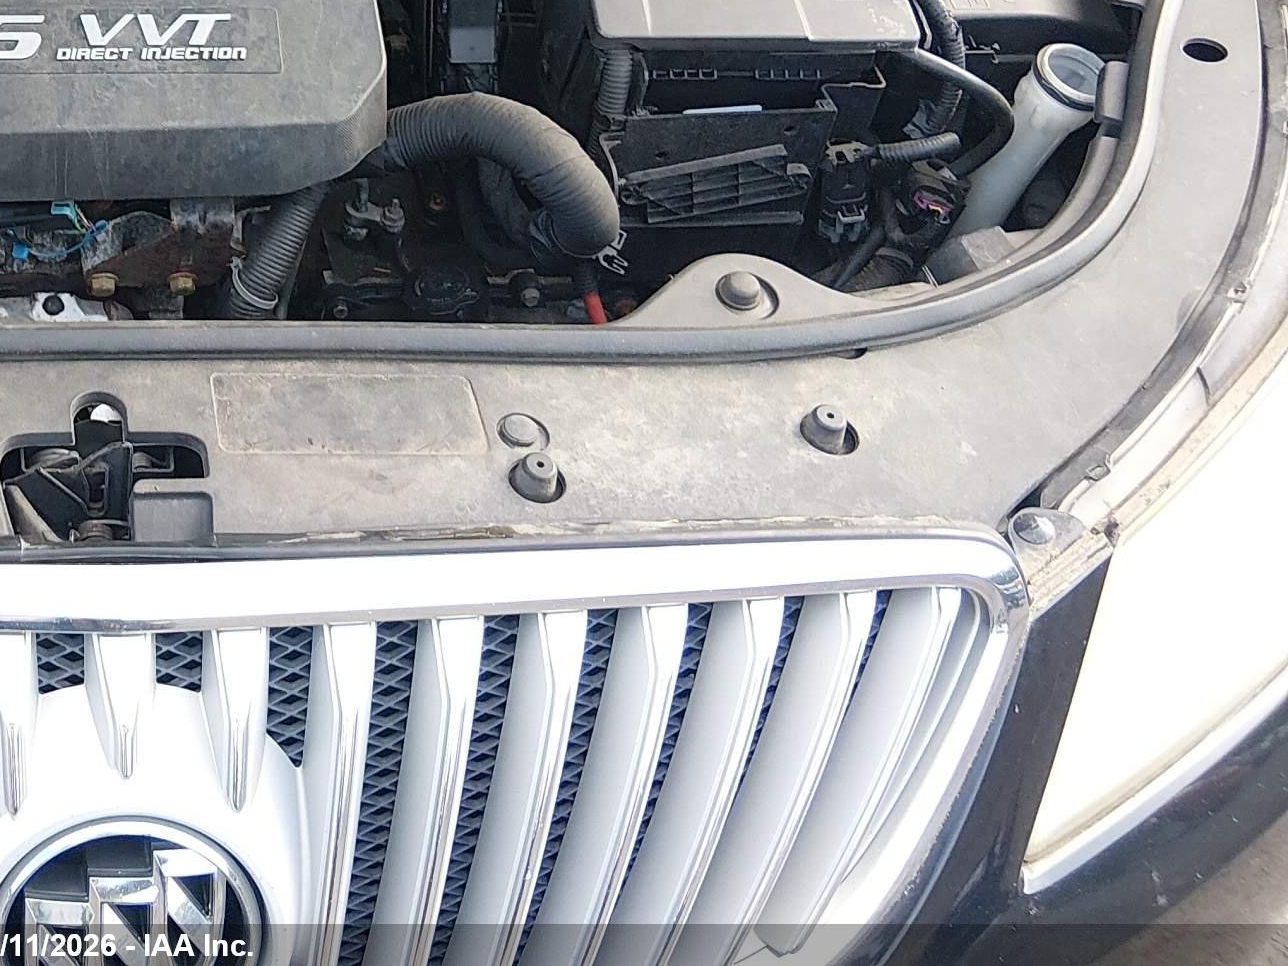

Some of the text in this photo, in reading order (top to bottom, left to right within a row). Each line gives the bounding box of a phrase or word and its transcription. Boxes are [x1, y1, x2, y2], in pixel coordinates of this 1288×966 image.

[79, 13, 232, 46] VVT
[56, 47, 247, 60] DIRECT INJECTION
